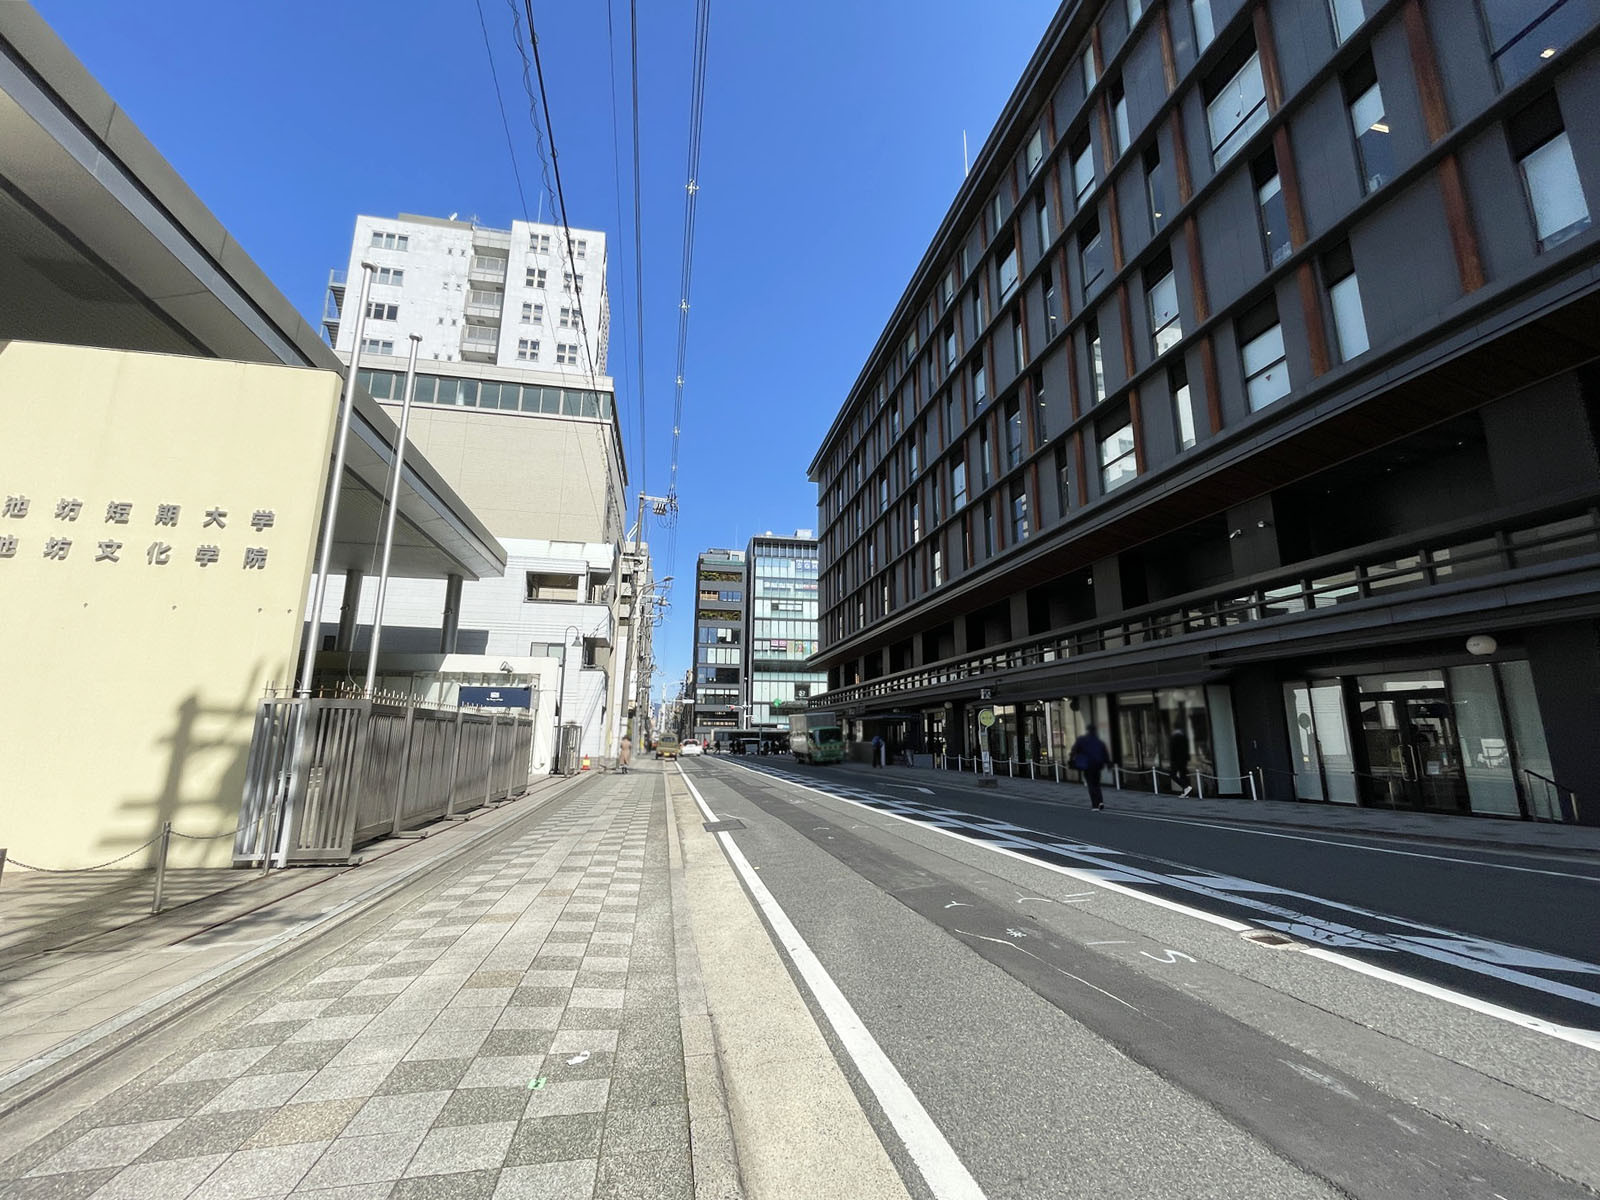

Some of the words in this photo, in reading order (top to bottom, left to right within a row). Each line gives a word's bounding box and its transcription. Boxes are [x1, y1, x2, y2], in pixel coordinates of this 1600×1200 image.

[2, 495, 275, 532] 池坊短期大学
